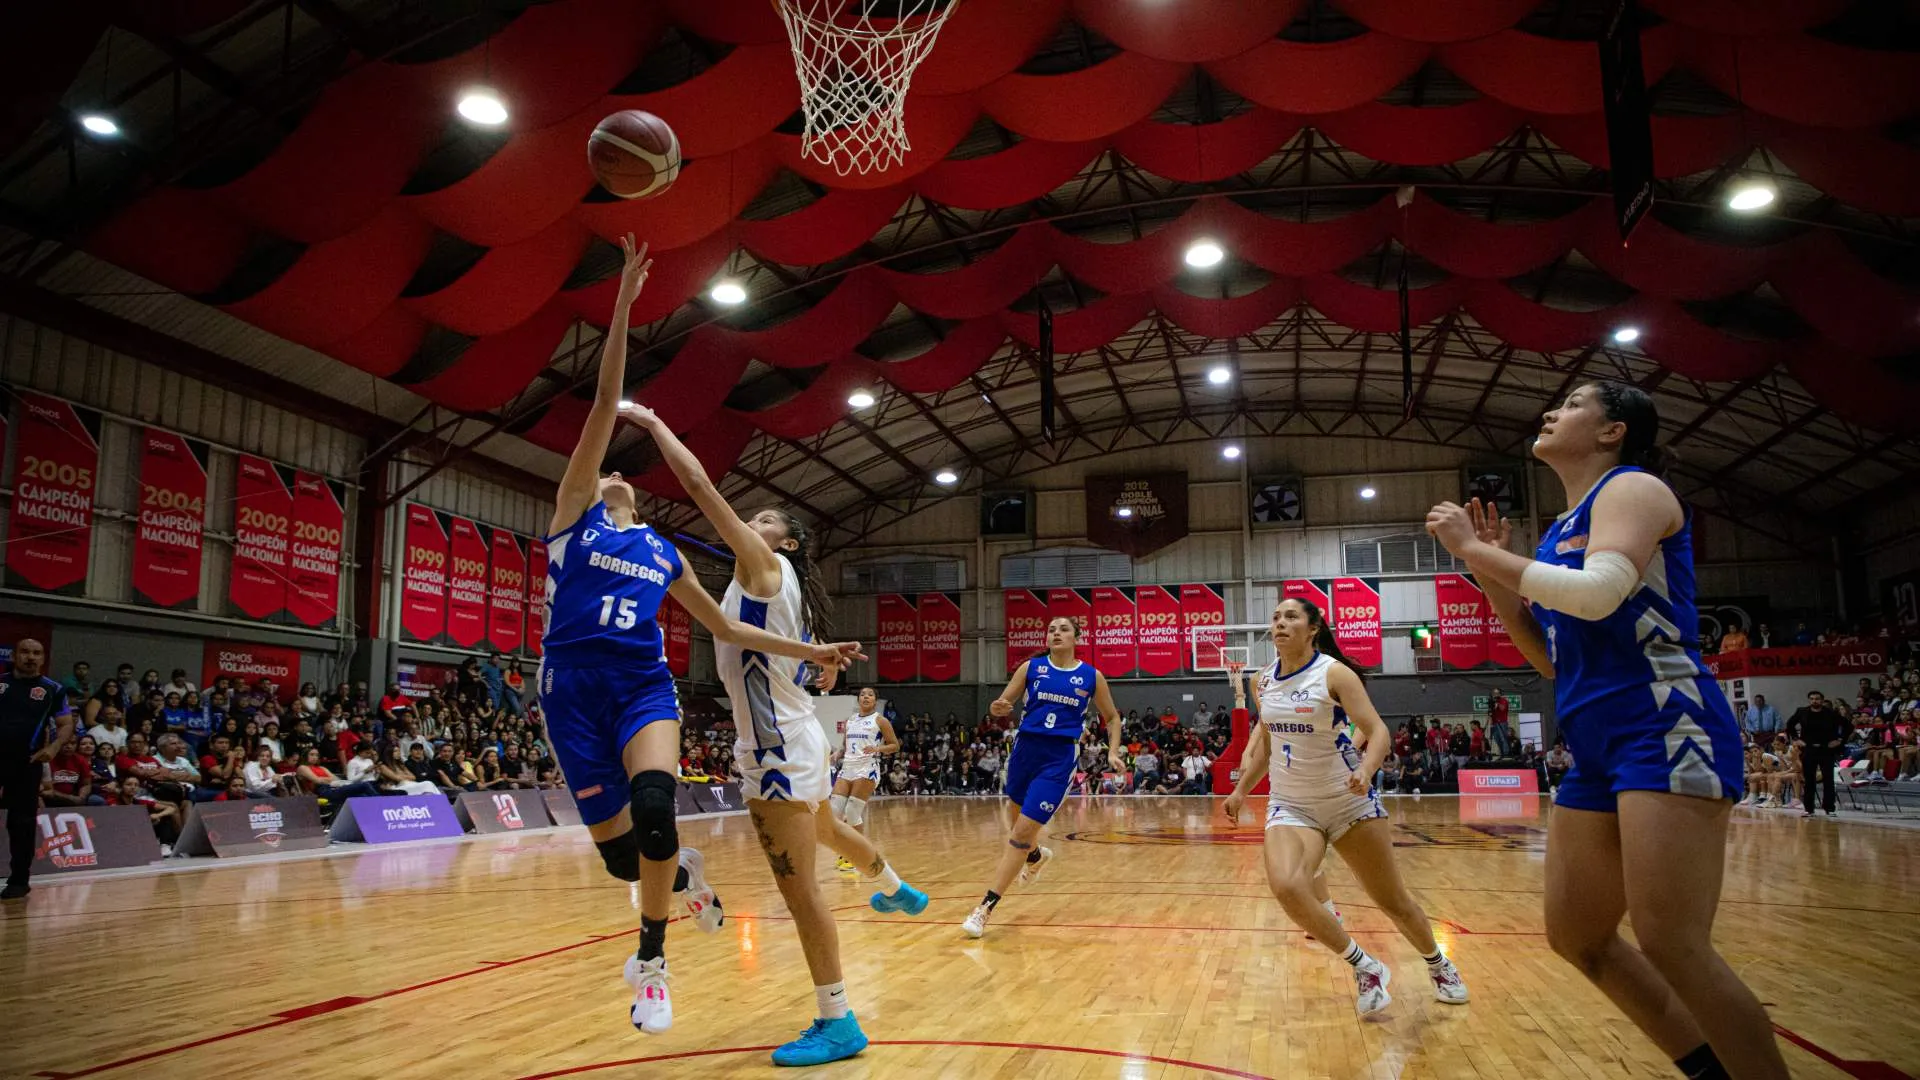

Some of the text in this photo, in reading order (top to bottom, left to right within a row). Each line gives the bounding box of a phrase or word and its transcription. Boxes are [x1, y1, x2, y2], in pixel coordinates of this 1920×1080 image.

[21, 455, 93, 490] 2005
[1124, 480, 1149, 491] 2012
[18, 482, 91, 511] CAMPEÓN
[143, 485, 203, 515] 2004
[1120, 490, 1153, 499] DOBLE
[17, 501, 88, 528] NACIONAL
[1108, 504, 1166, 518] NIONAL
[142, 509, 201, 533] CAMPEÓN
[239, 506, 289, 535] 2002
[141, 527, 200, 549] NACIONAL
[236, 529, 288, 552] CAMPEÓN
[293, 521, 341, 547] 2000
[236, 544, 286, 566] NACIONAL
[292, 541, 339, 562] CAMPEÓN
[409, 546, 445, 570] 1999
[292, 556, 337, 576] NACIONAL
[453, 556, 486, 578] 1999
[588, 551, 667, 588] BORREGOS
[407, 566, 445, 584] CAMPEÓN
[493, 567, 524, 588] 1999
[406, 578, 444, 597] NACIONAL
[451, 576, 486, 594] CAMPEÓN
[531, 575, 546, 592] 19
[451, 588, 485, 605] NACIONAL
[492, 584, 523, 602] CAMPEÓN
[491, 597, 522, 612] NACIONAL
[1440, 602, 1480, 617] 1987
[599, 595, 638, 630] 15
[1140, 611, 1177, 626] 1992
[1183, 611, 1223, 625] 1990
[1338, 606, 1377, 620] 1989
[881, 620, 915, 633] 1996
[922, 620, 958, 632] 1996
[1008, 616, 1045, 629] 1996
[1096, 614, 1132, 627] 1993
[1337, 619, 1379, 631] CAMPEÓN
[1440, 615, 1483, 627] CAMPEÓN
[880, 632, 916, 642] CAMPEÓN
[921, 631, 960, 642] CAMPEÓN
[1008, 628, 1046, 640] CAMPEÓN
[1095, 626, 1134, 638] CAMPEÓN
[1139, 625, 1178, 638] CAMPEÓN
[1338, 630, 1379, 639] NACIONAL
[1441, 626, 1483, 636] NACIONAL
[880, 642, 916, 650] NACIONAL
[922, 642, 959, 650] NACIONAL
[1008, 639, 1045, 648] NACIONAL
[1095, 636, 1134, 646] NACIONAL
[1140, 635, 1179, 645] NACIONAL
[219, 650, 253, 663] SOMOS
[1837, 653, 1881, 668] ALTO
[1037, 692, 1080, 707] BORREGOS
[1044, 712, 1057, 729] 9
[1282, 745, 1291, 768] 7
[383, 806, 432, 821] molten
